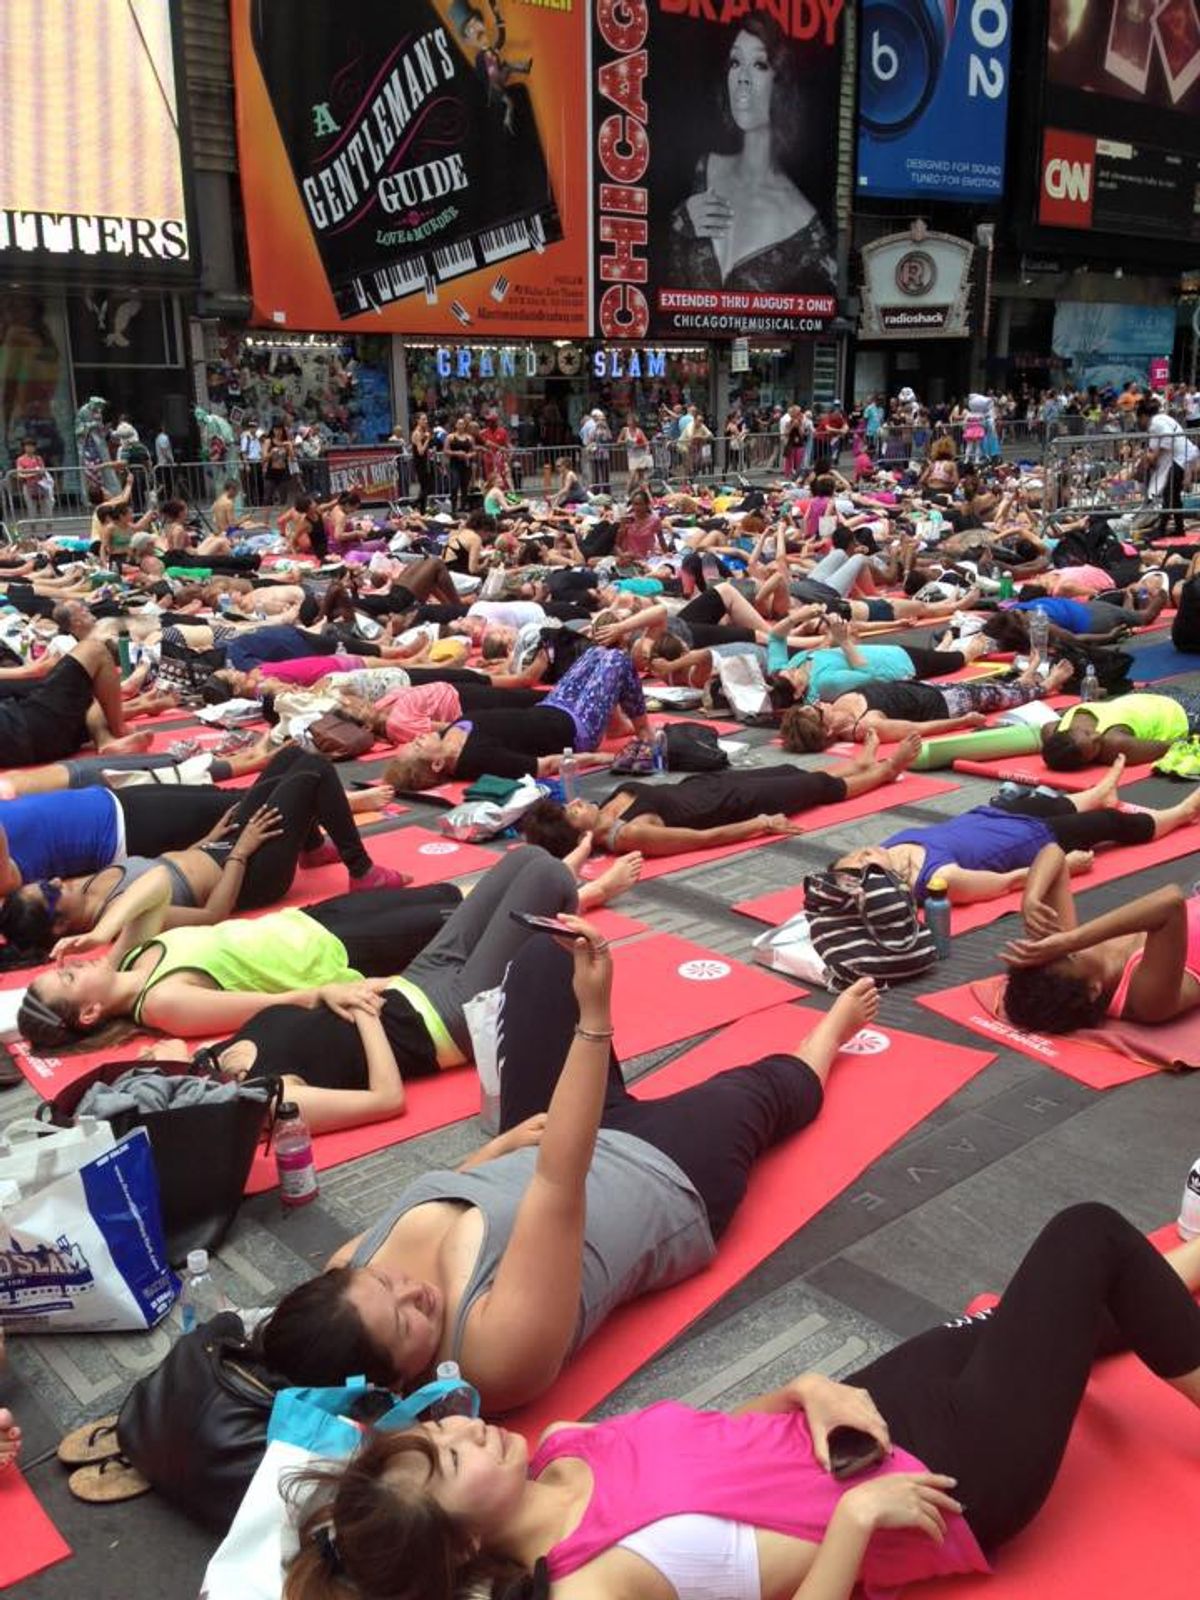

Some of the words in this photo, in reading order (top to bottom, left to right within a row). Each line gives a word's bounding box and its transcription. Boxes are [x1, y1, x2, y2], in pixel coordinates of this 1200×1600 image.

[659, 0, 845, 45] ANDY
[302, 26, 455, 230] GENTLEMAN'S
[312, 101, 341, 137] A
[906, 157, 950, 172] DESIGNED
[952, 160, 970, 172] FOR
[971, 163, 1001, 176] SOUND
[911, 172, 941, 185] TUNED
[941, 174, 960, 186] FOR
[961, 176, 1001, 189] EMOTION
[1045, 158, 1091, 203] CNN
[377, 153, 469, 214] GUIDE
[2, 209, 187, 259] ITTERS
[375, 229, 407, 247] LOVE
[661, 293, 717, 307] EXTENDED
[720, 295, 750, 309] THRU
[752, 297, 794, 311] AUGUST
[798, 299, 804, 311] 2
[806, 299, 833, 312] ONLY
[673, 314, 823, 331] CHICAGOTHEMUSICAL.COM
[884, 312, 944, 326] radioshack
[437, 347, 537, 378] GRAND
[594, 349, 666, 378] SLAM
